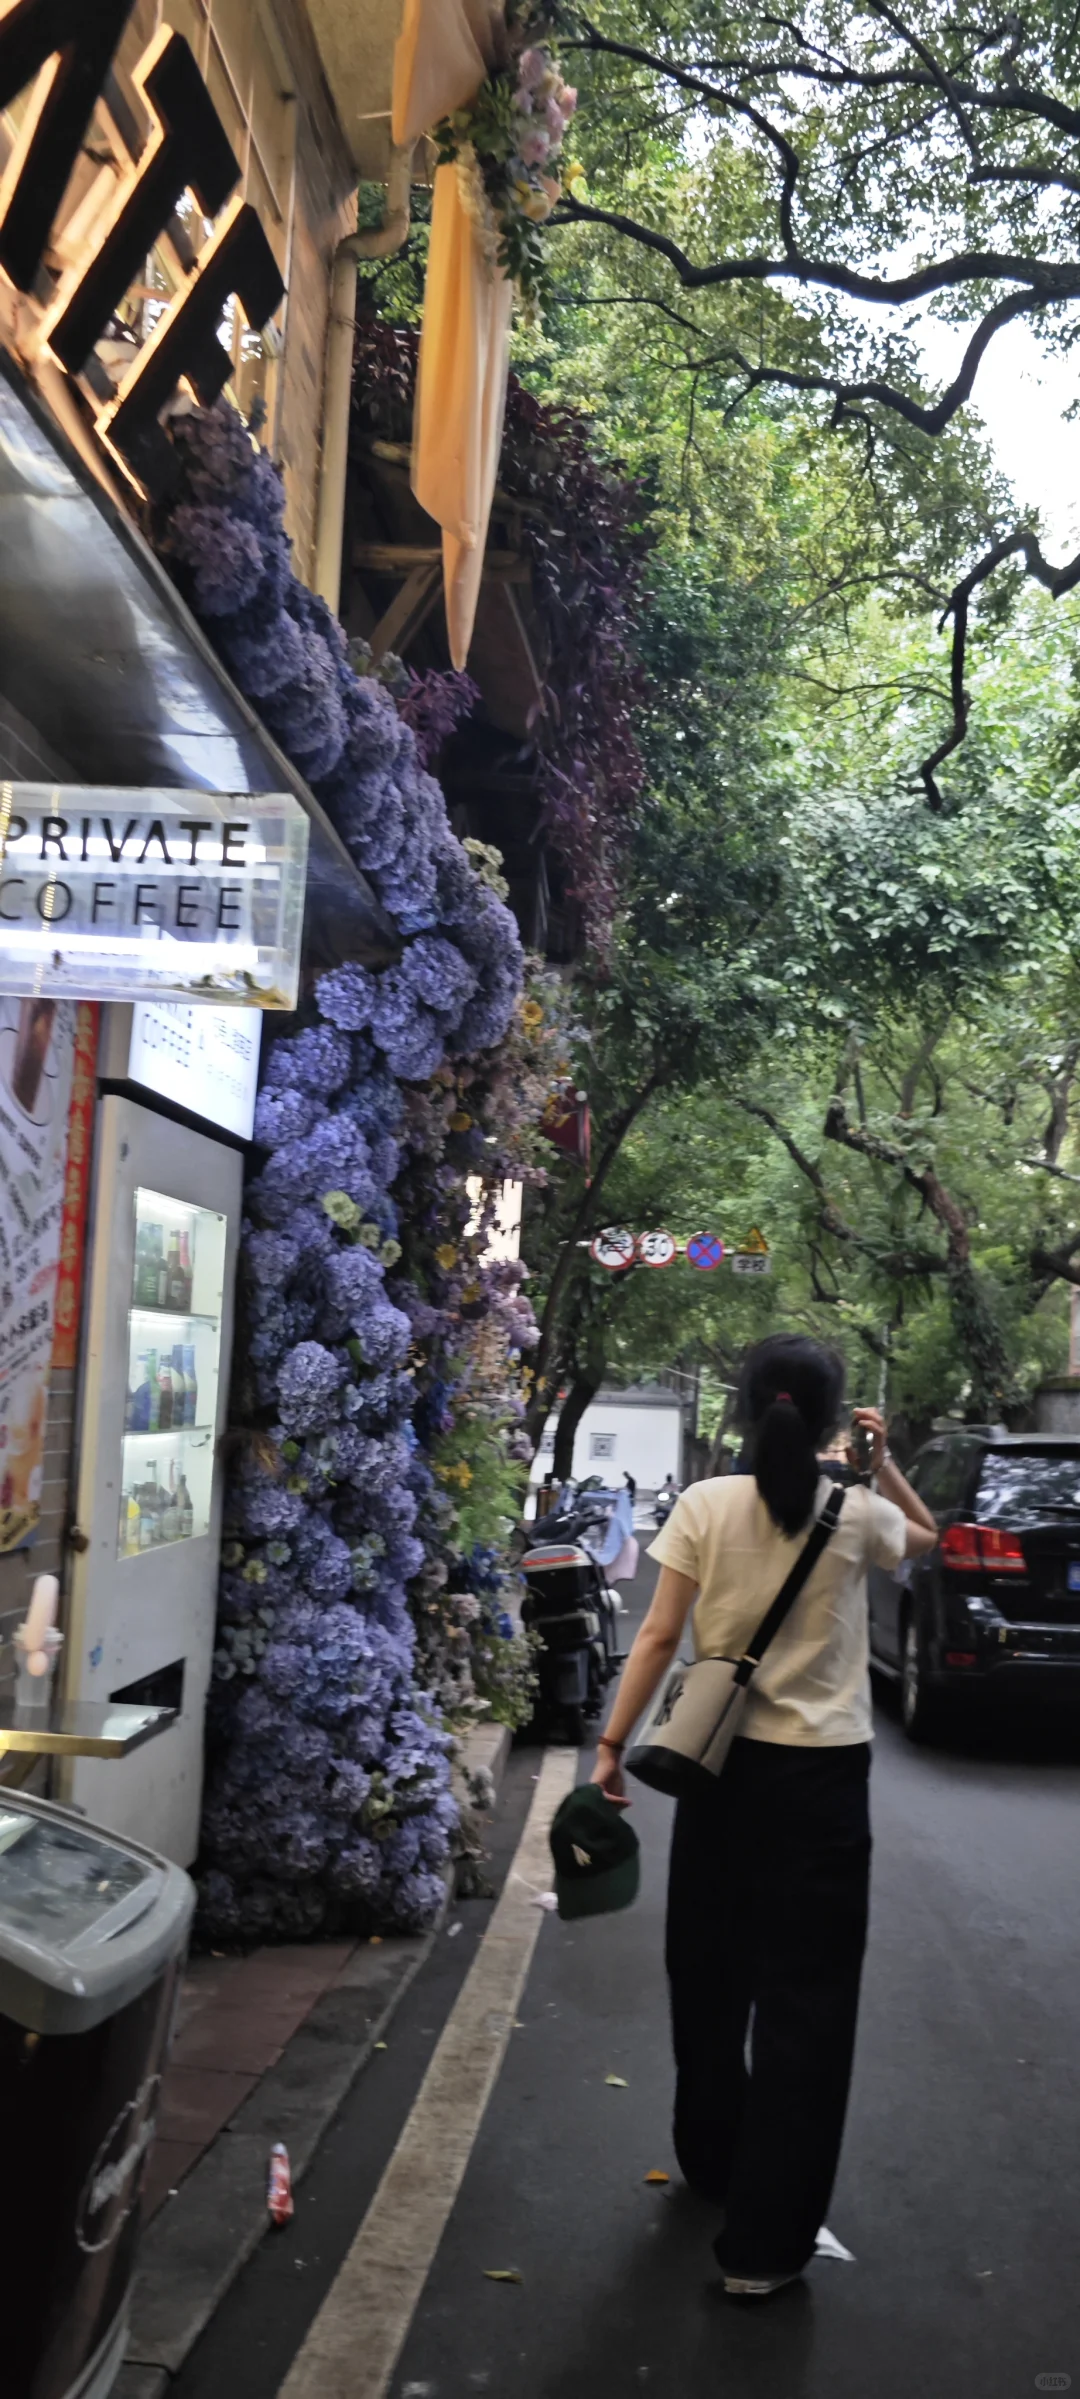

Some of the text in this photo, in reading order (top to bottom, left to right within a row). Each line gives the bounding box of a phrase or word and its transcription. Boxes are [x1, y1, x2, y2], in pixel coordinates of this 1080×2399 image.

[0, 815, 250, 868] PRIVATE
[0, 878, 243, 929] COFFEE
[644, 1237, 668, 1258] 30
[736, 1257, 767, 1273] 学校
